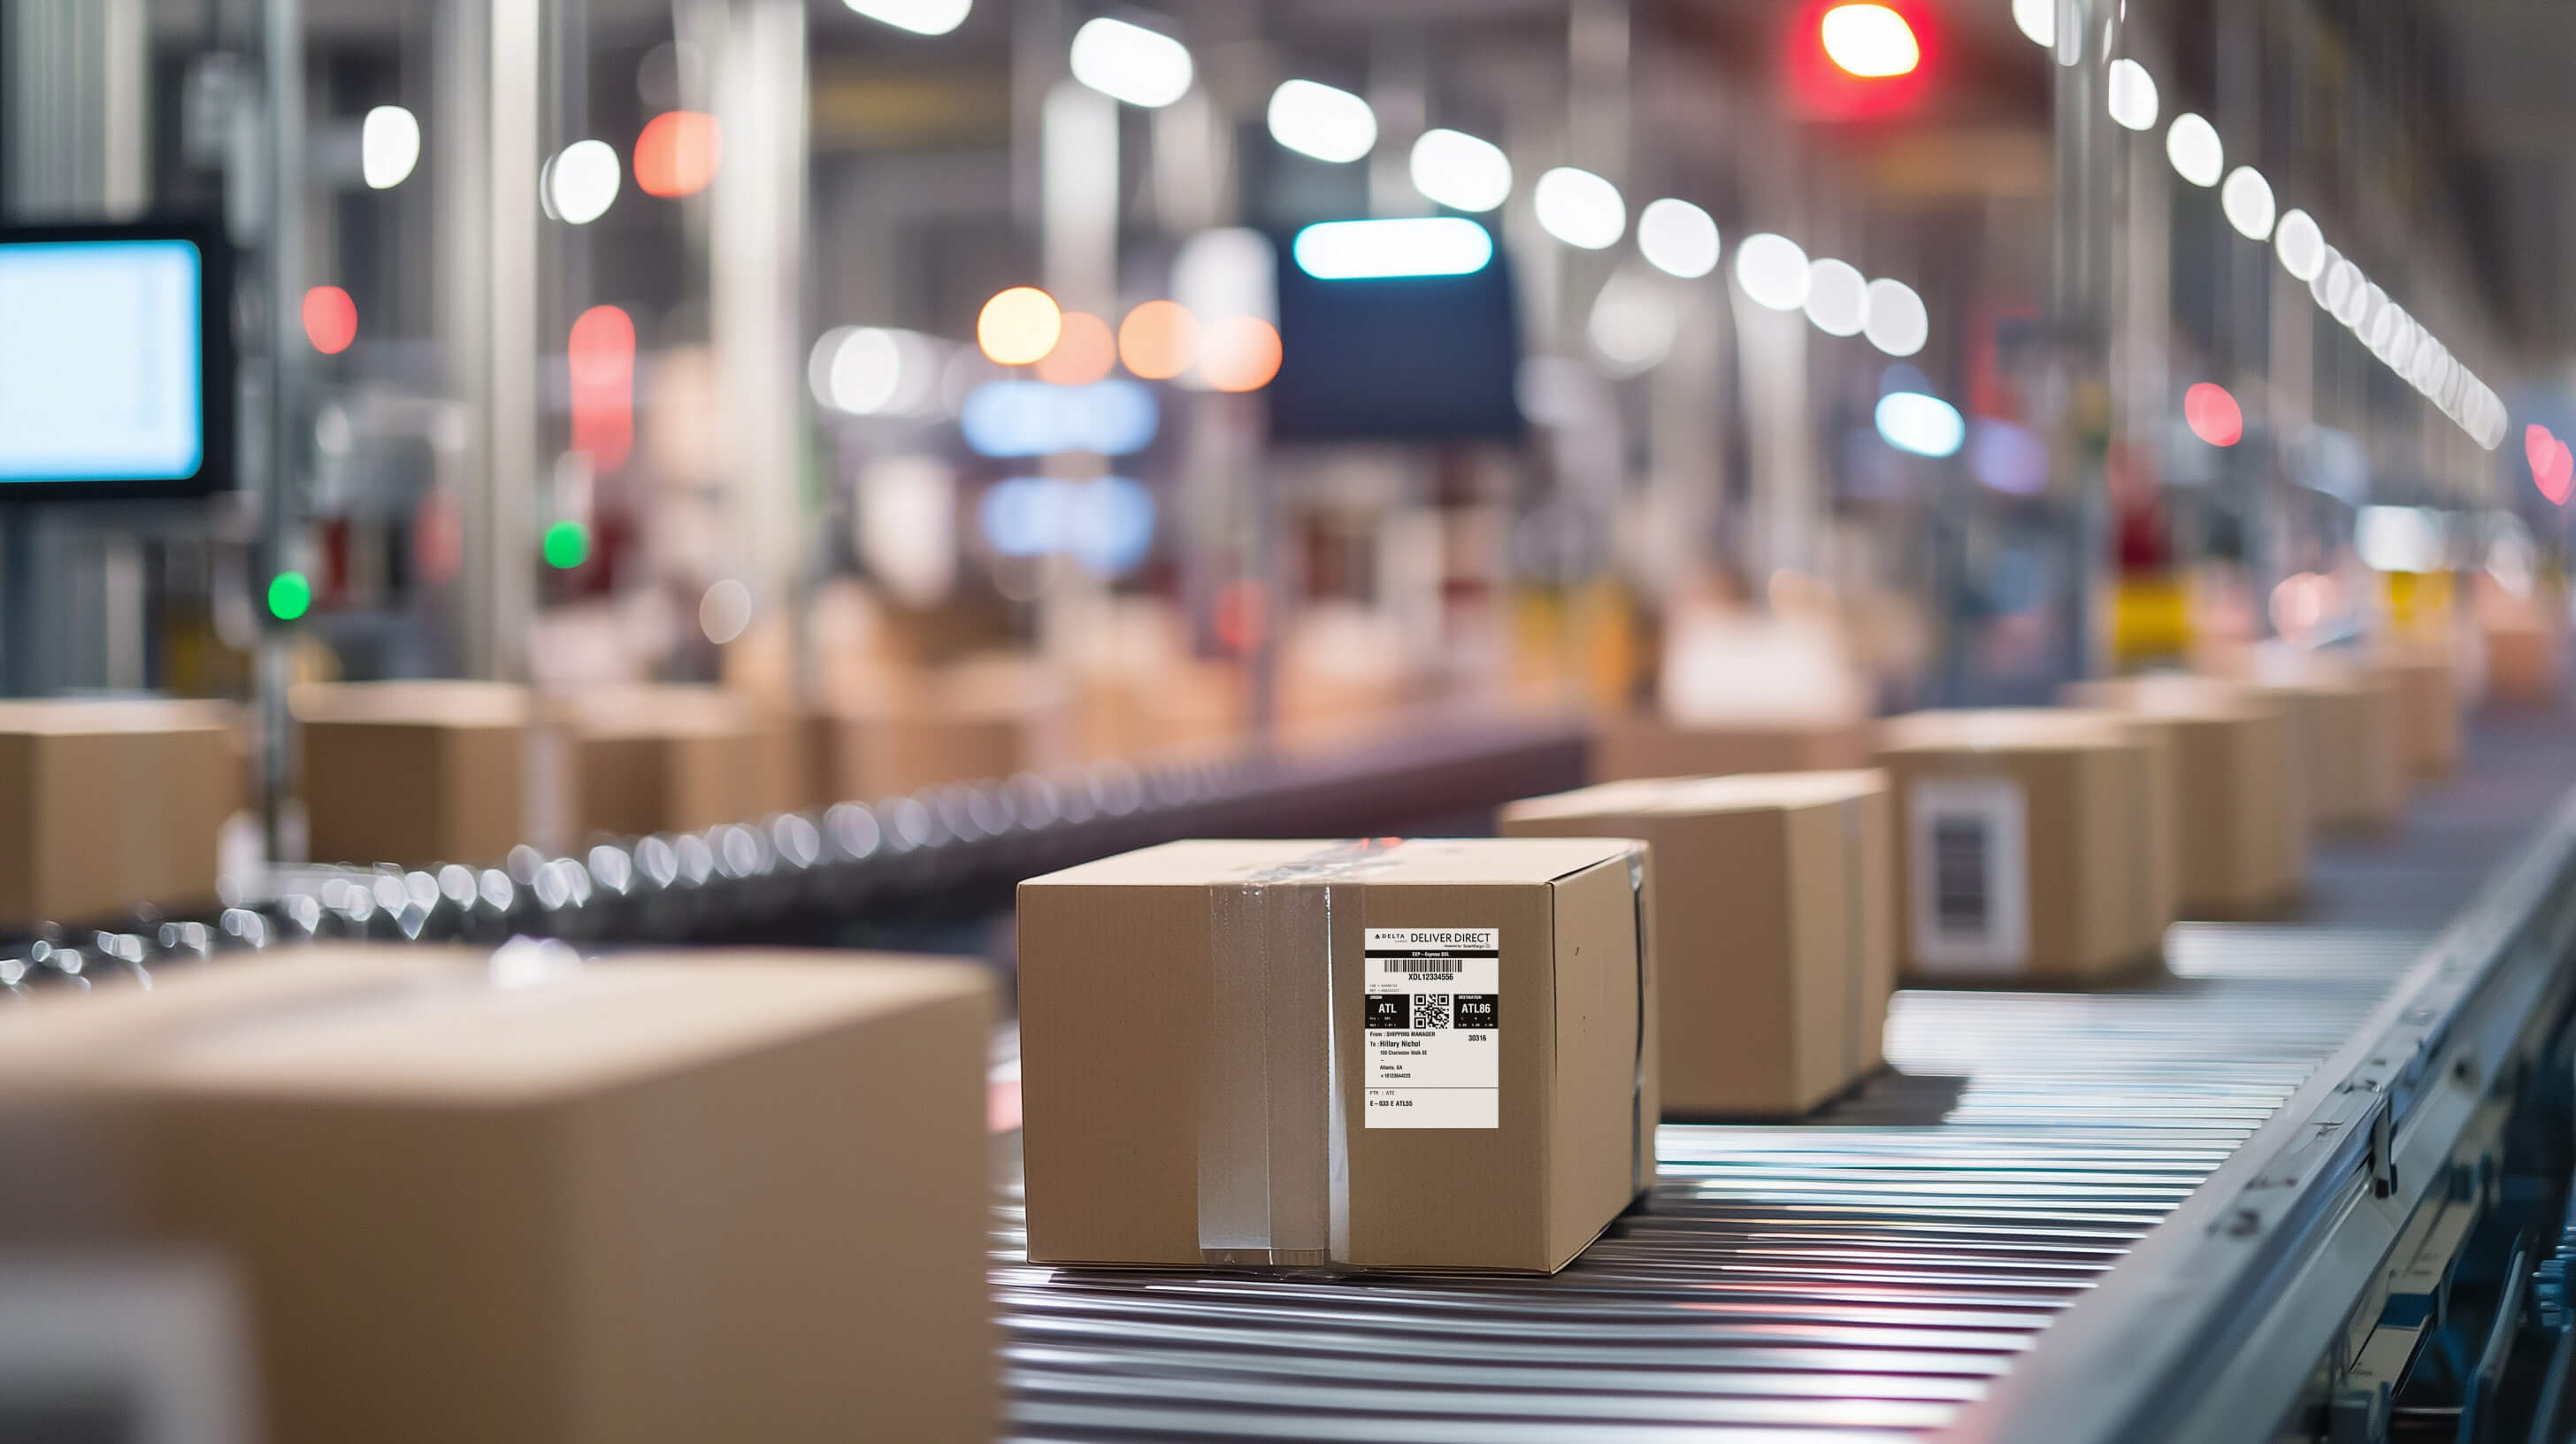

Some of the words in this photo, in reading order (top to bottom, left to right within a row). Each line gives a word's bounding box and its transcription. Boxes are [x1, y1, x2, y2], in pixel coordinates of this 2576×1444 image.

[1410, 933, 1452, 942] DELIVER
[1454, 933, 1491, 942] DIRECT
[1378, 1003, 1397, 1013] ATL
[1461, 1003, 1491, 1013] ATL86
